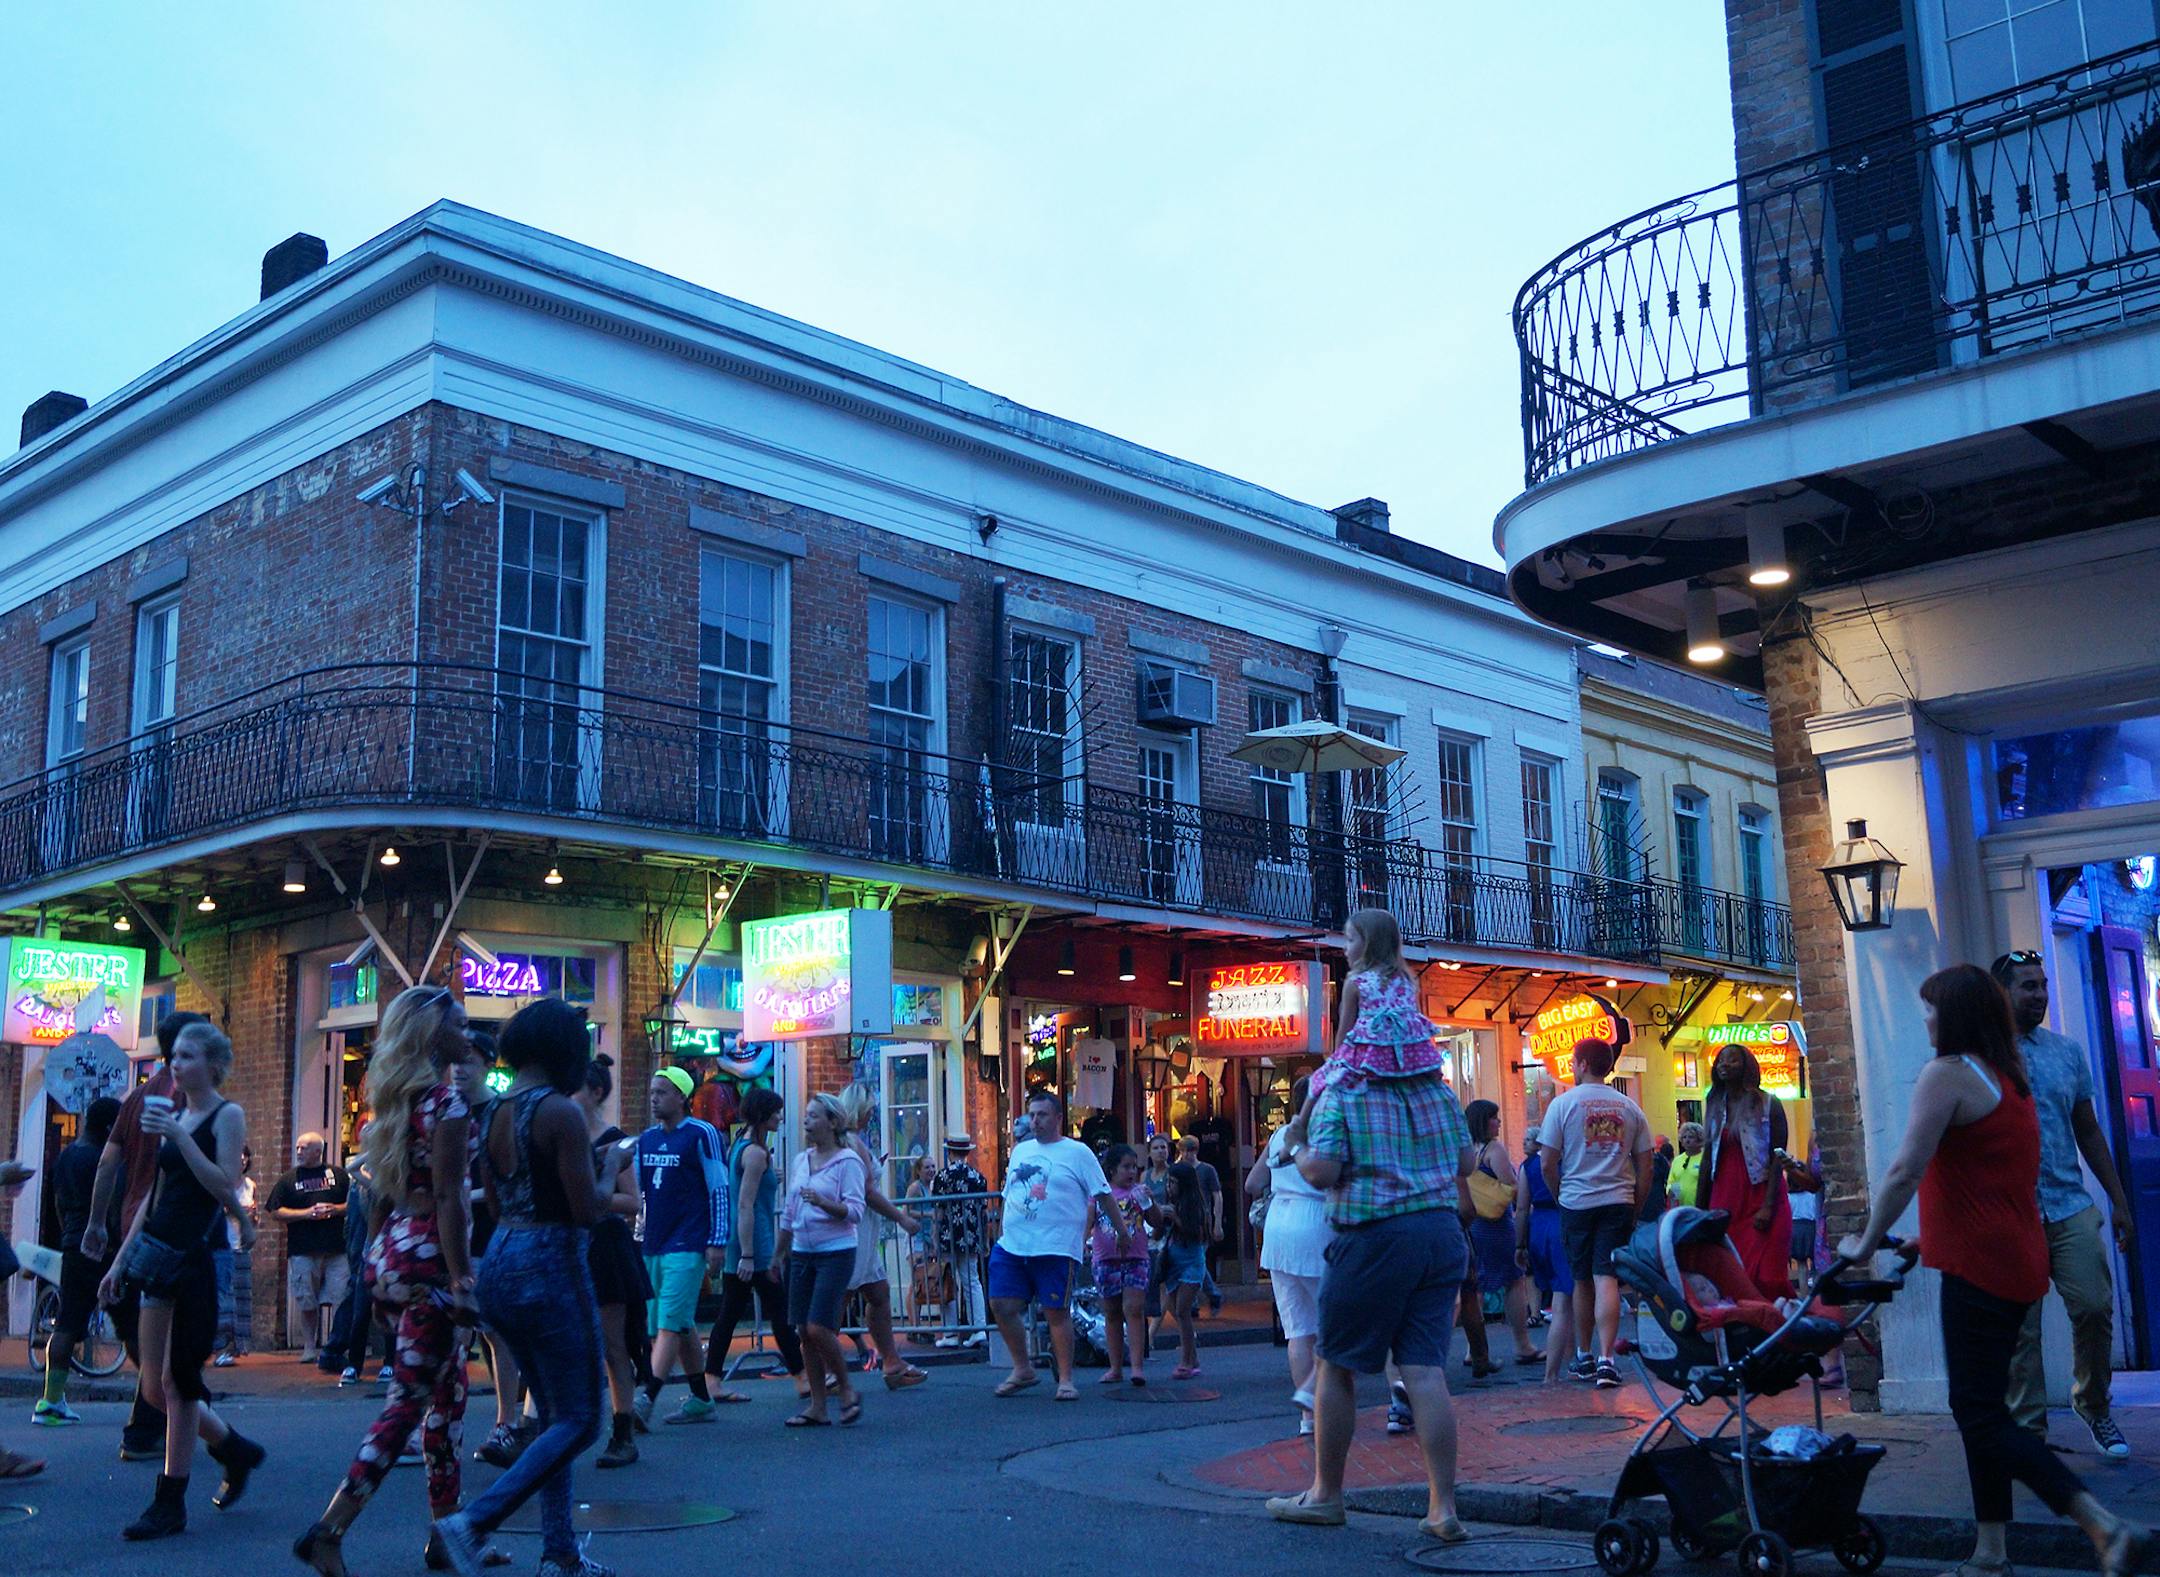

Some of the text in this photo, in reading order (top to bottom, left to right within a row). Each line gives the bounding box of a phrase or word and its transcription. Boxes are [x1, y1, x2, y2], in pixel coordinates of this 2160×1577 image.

[752, 916, 850, 967] JESTER
[18, 947, 129, 987] JESTER
[463, 957, 541, 992] PIZZA
[1211, 965, 1285, 989] JAZZ
[772, 1020, 797, 1033] AND
[1198, 1014, 1299, 1040] FUNERAL
[1537, 999, 1597, 1031] BIG EASY
[35, 1027, 65, 1039] AND
[1709, 1024, 1769, 1044] Willie's
[1082, 1064, 1107, 1073] BACON
[652, 1166, 663, 1189] 4
